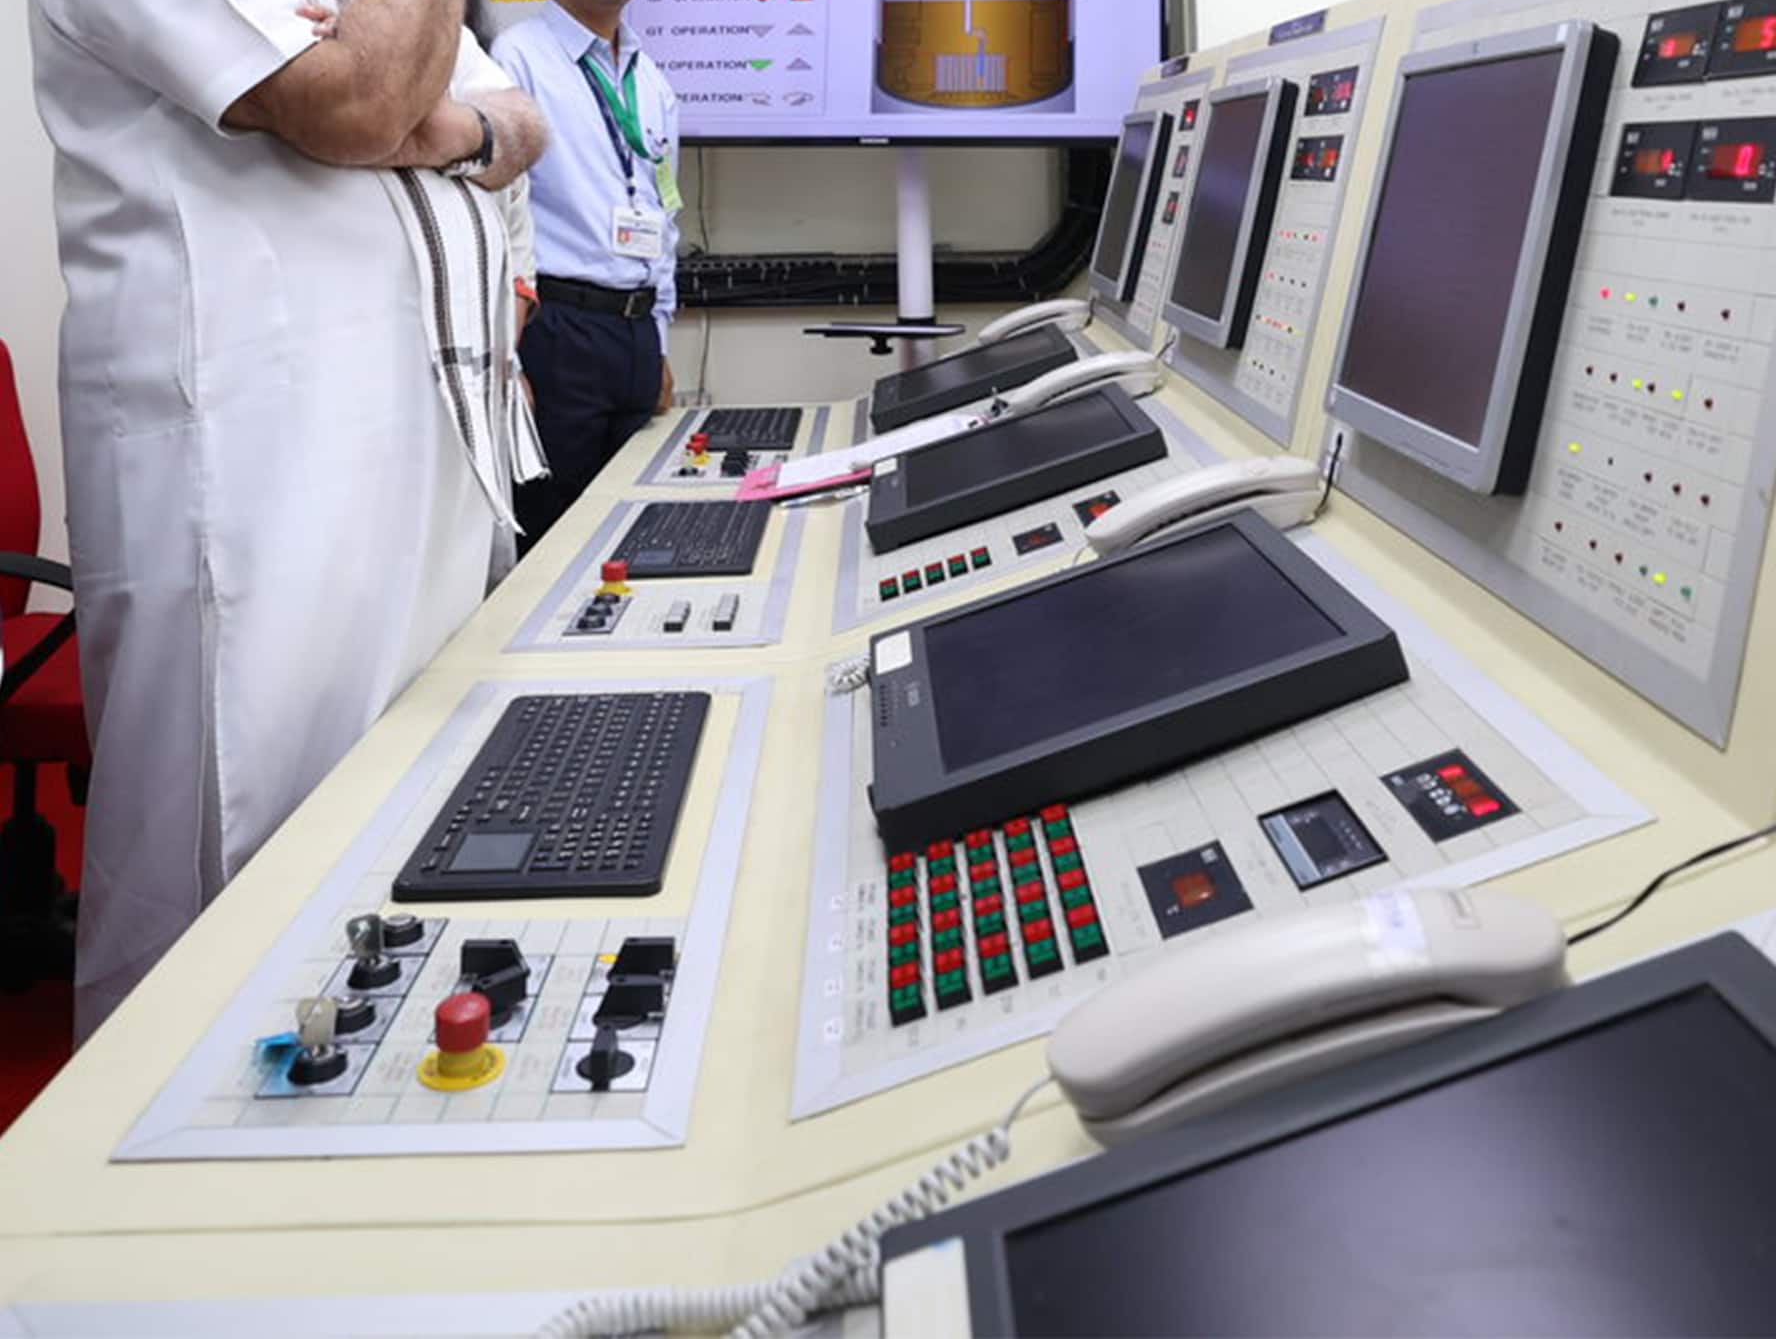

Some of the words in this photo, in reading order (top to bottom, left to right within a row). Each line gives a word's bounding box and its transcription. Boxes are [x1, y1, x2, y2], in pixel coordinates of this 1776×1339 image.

[670, 25, 750, 36] OPERATION
[667, 60, 748, 71] OPERATION
[674, 92, 744, 103] PERATION
